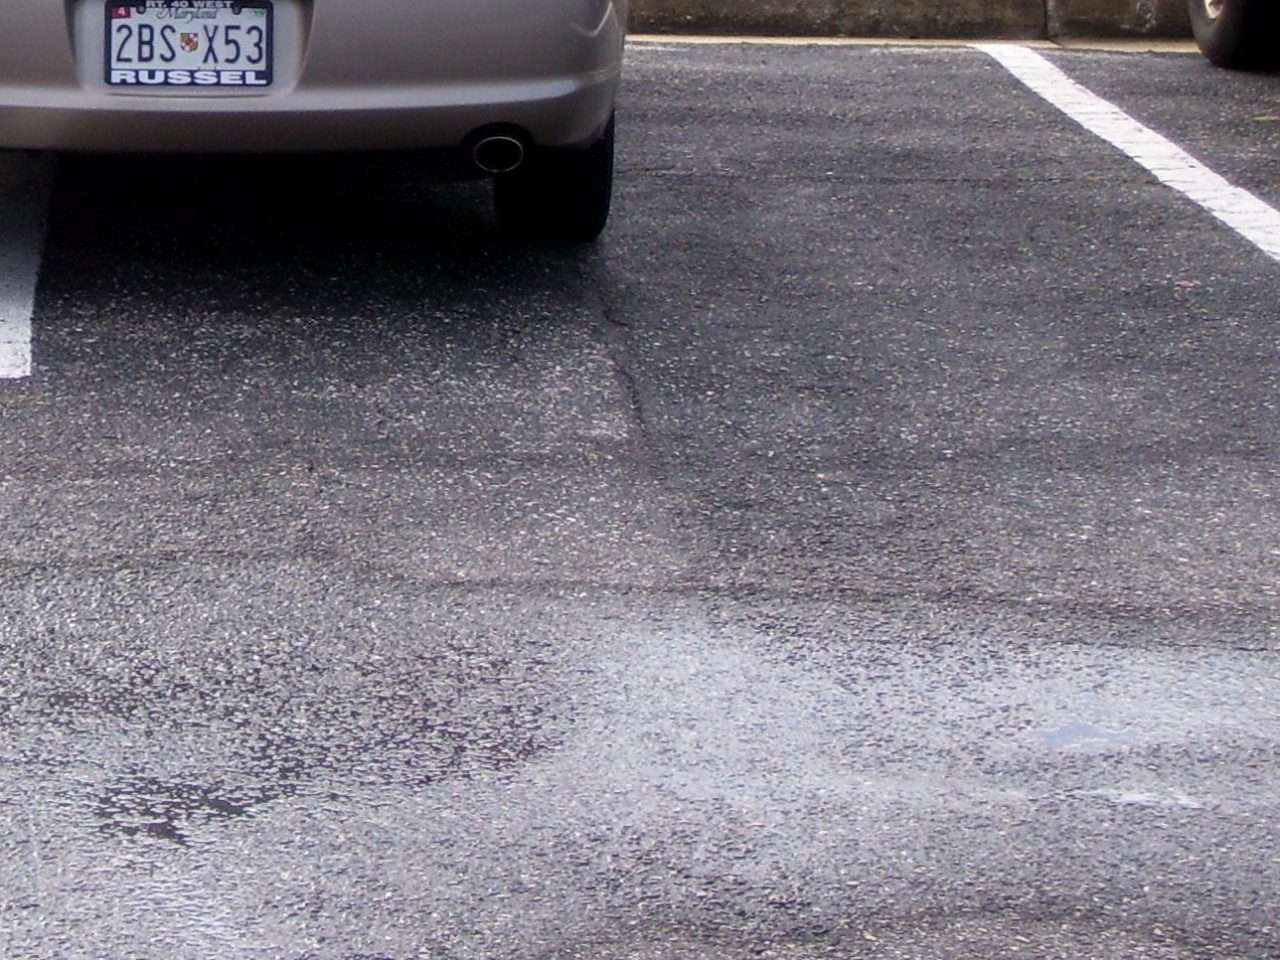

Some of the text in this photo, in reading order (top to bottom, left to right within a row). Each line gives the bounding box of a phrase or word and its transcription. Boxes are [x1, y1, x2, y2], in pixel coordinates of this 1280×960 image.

[146, 0, 233, 9] RT. 40 WEST
[115, 24, 264, 64] 2BS X53
[110, 70, 268, 85] RUSSEL
